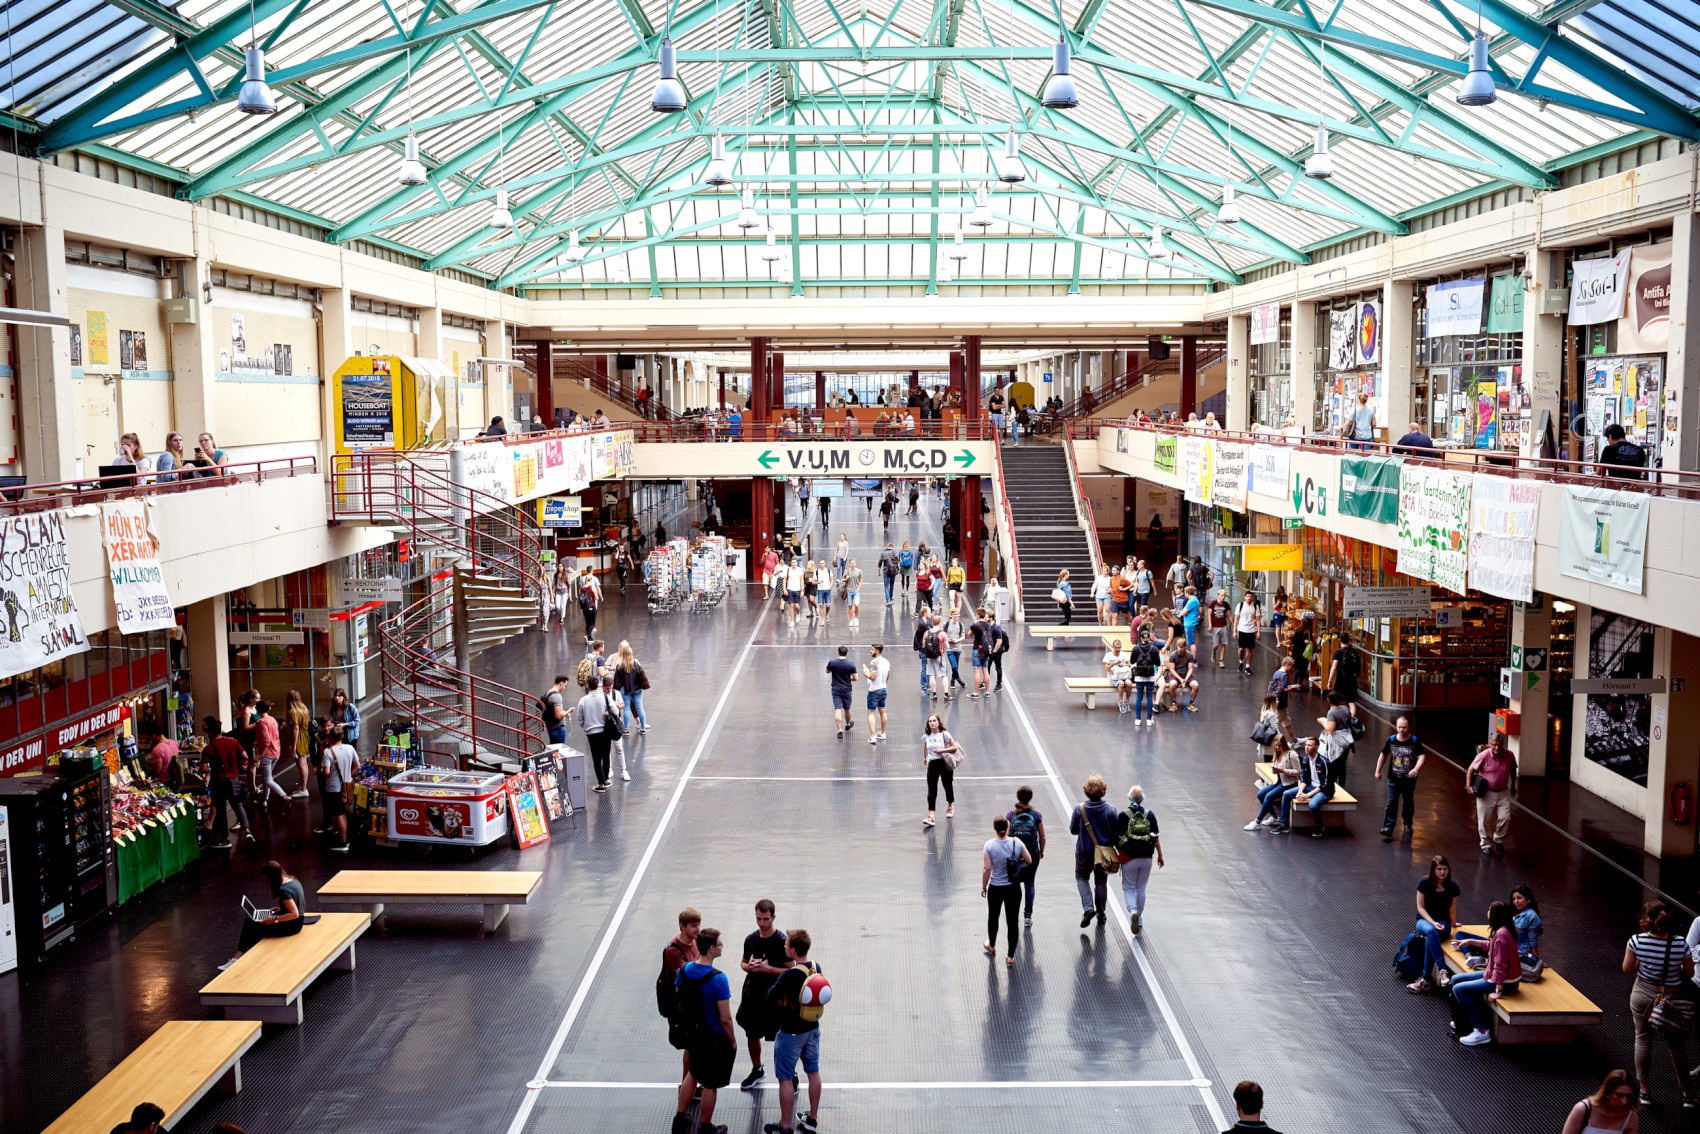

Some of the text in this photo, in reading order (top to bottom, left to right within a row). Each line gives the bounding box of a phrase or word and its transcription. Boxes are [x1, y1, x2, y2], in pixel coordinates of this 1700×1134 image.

[1642, 284, 1664, 300] Antifa
[1654, 300, 1662, 308] Uni
[348, 402, 387, 410] HOUSEBOAT
[884, 449, 947, 472] M,C,D
[546, 502, 579, 514] papershop
[1304, 477, 1314, 514] C
[1402, 473, 1421, 494] Urban
[1424, 475, 1458, 516] Gardening
[14, 511, 65, 555] SLAM
[108, 508, 133, 539] HÛN
[110, 539, 138, 562] XÊR
[28, 565, 71, 607] AMNESTY
[30, 595, 78, 624] INTERNATIONAL
[58, 706, 121, 746] EDDY IN DER UNI
[6, 747, 24, 769] DER
[26, 739, 42, 760] UNI
